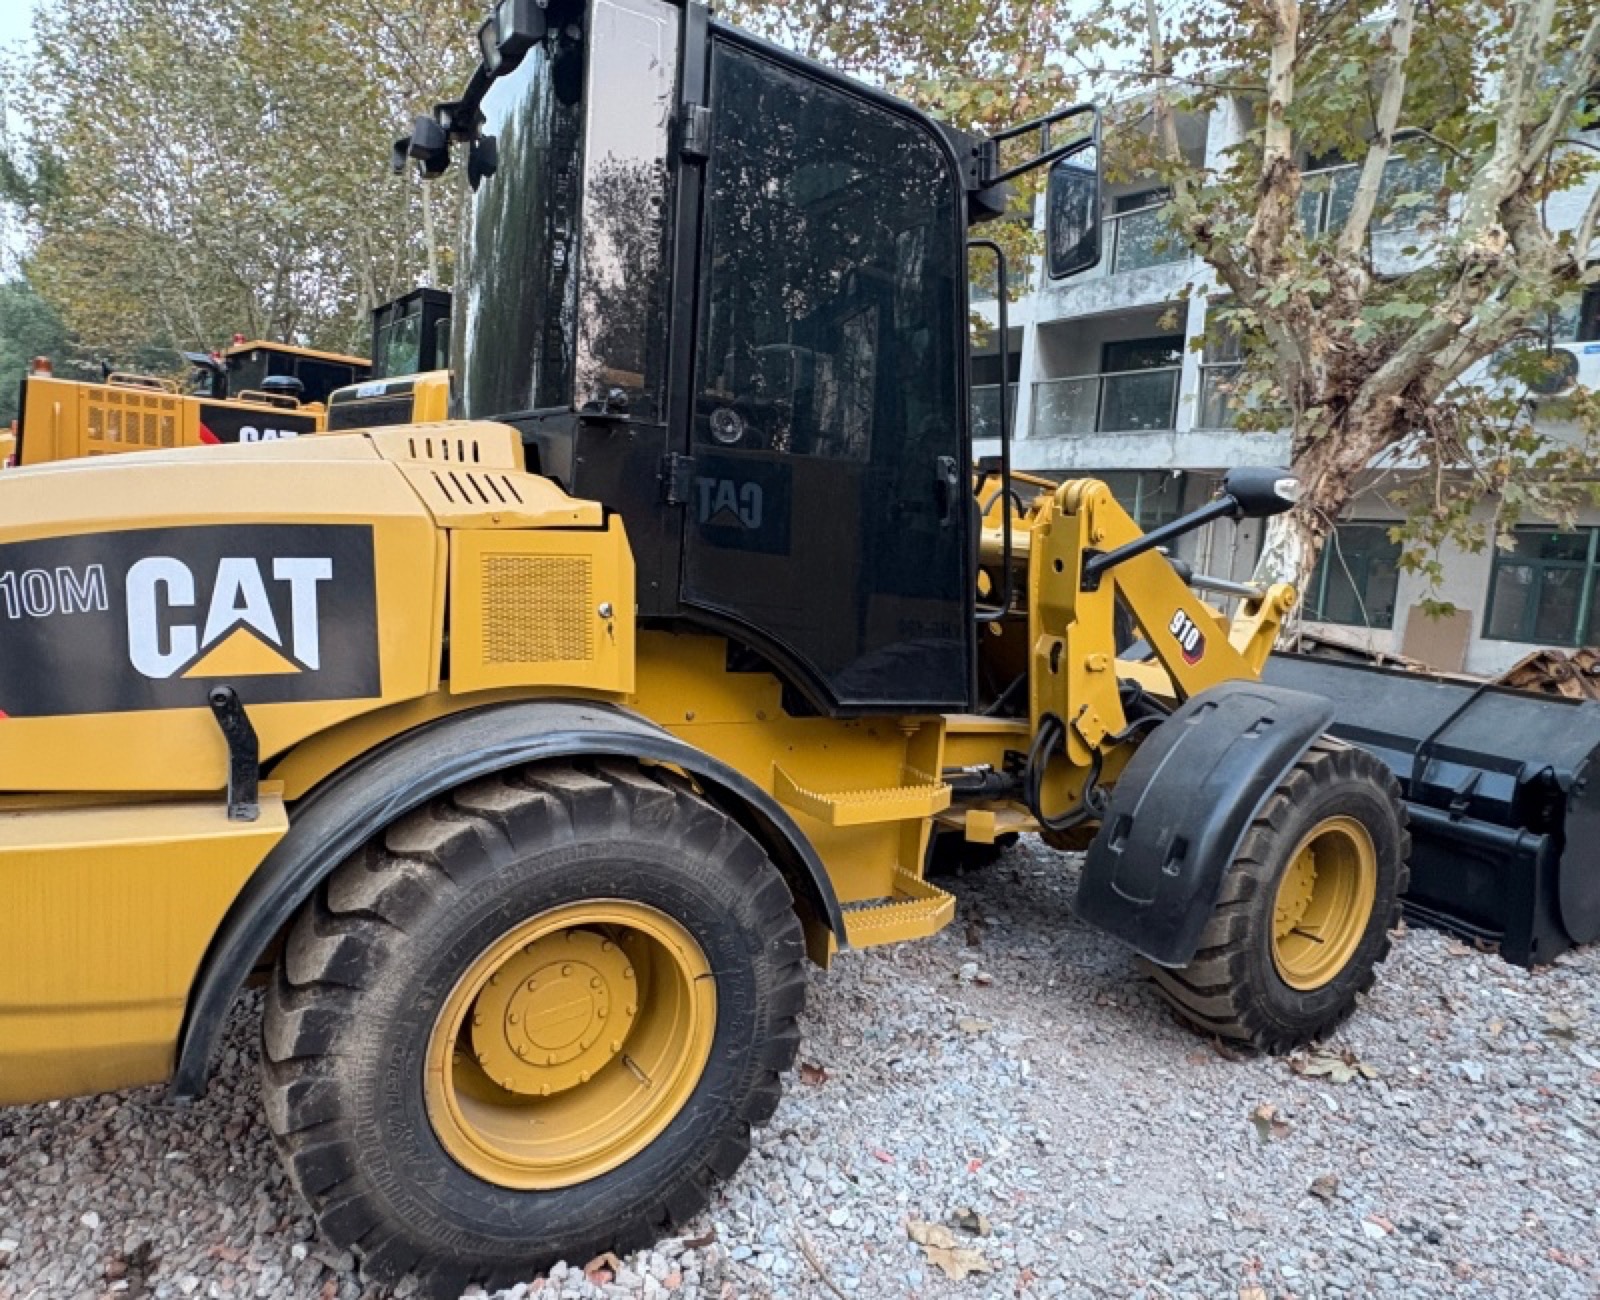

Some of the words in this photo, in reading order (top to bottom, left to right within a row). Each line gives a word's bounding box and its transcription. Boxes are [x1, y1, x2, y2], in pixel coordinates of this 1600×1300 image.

[239, 426, 299, 442] CA
[126, 556, 333, 678] CAT
[1169, 609, 1199, 651] 910
